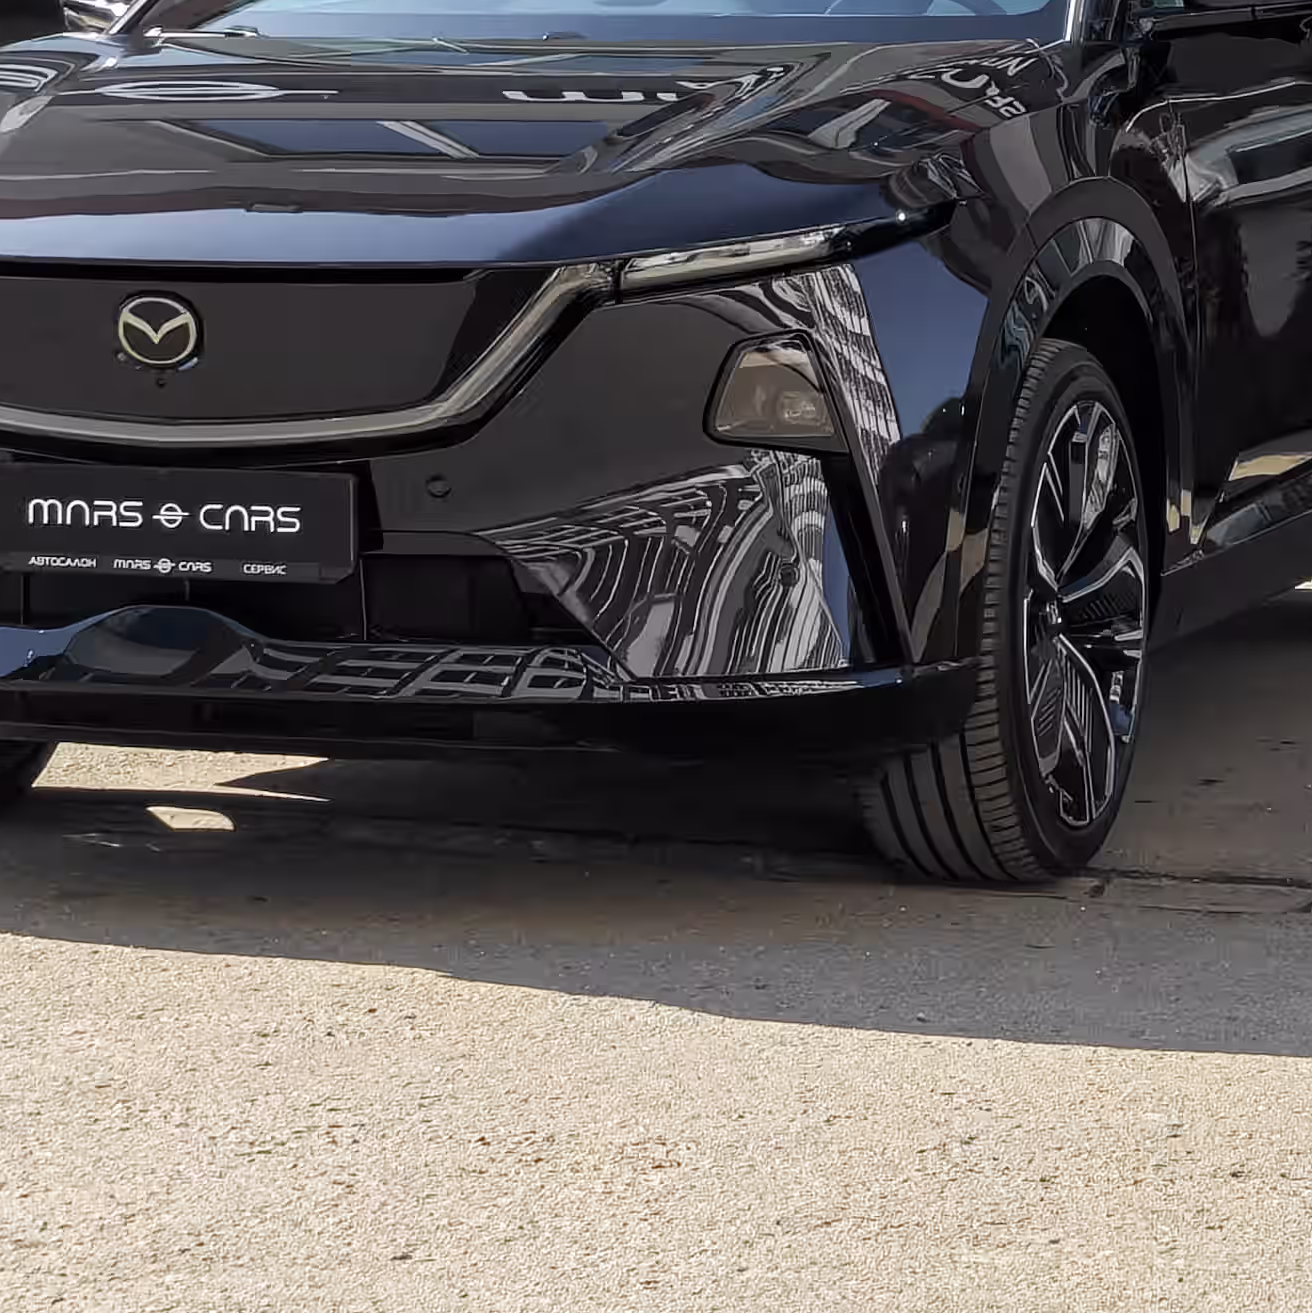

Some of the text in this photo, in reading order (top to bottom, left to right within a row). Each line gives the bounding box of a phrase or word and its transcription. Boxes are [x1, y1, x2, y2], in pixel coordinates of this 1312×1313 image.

[27, 498, 301, 534] MARS CARS
[27, 556, 98, 568] АВТОСАЛОН
[113, 558, 212, 573] MARS CARS
[243, 563, 287, 575] СЕРВИС
